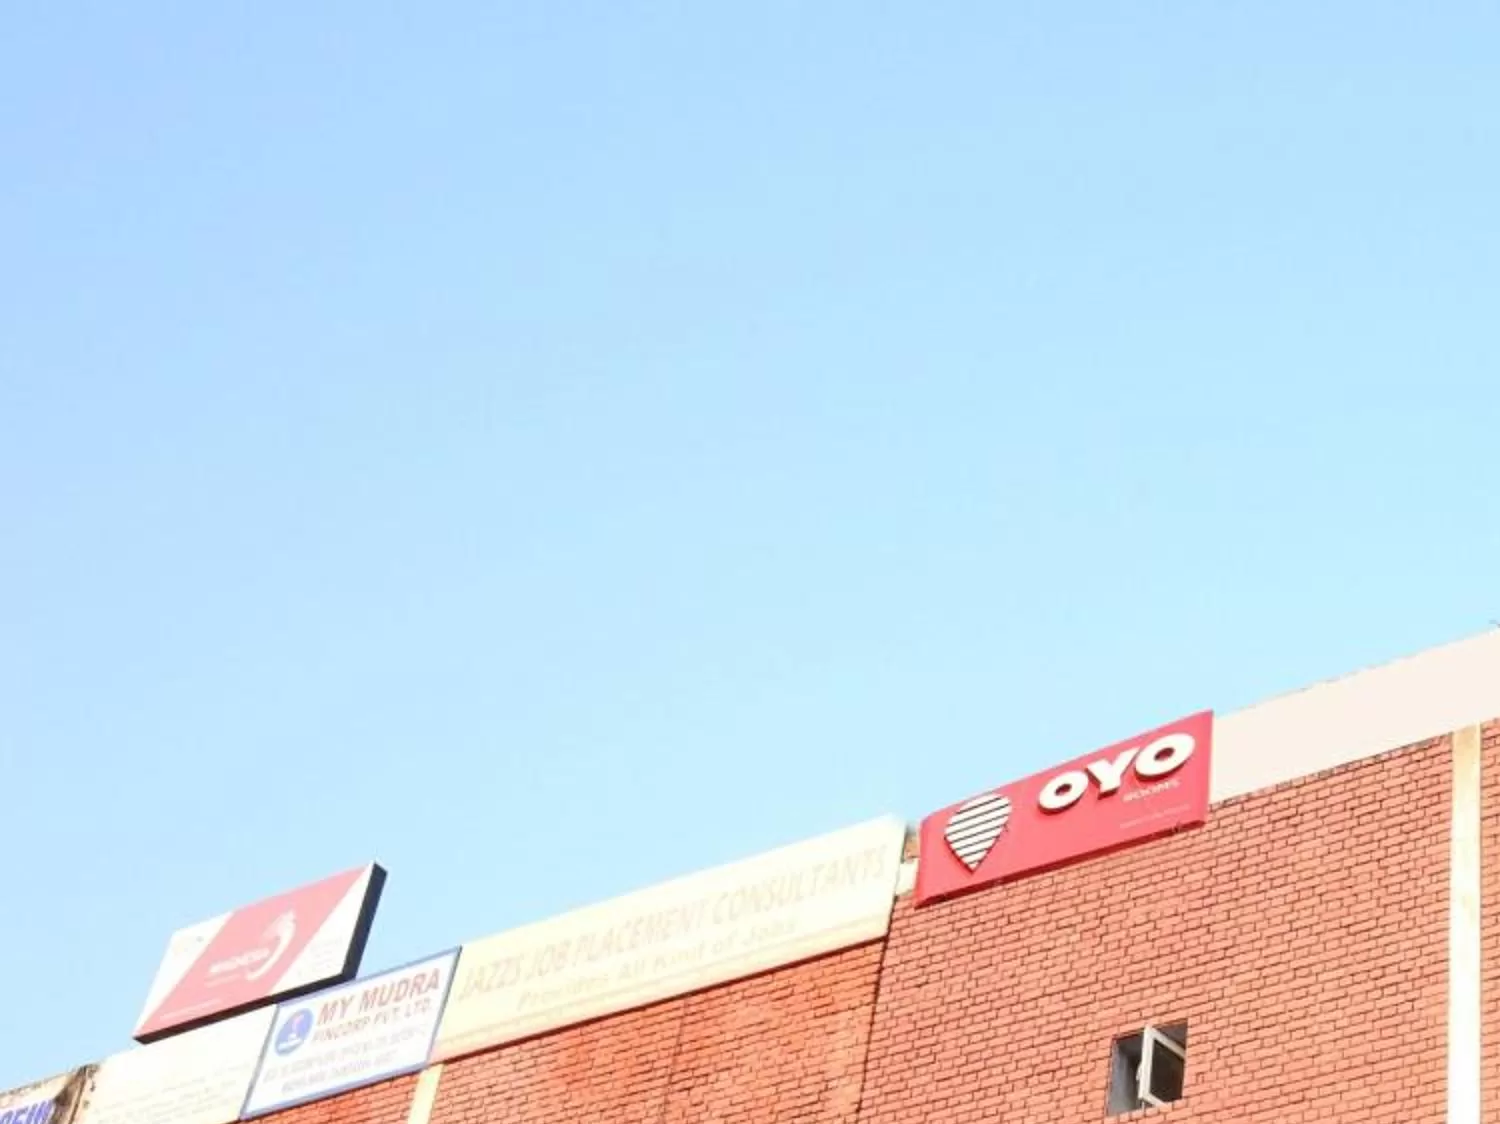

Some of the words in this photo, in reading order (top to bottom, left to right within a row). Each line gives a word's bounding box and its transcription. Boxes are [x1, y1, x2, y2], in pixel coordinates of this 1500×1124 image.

[1036, 732, 1196, 815] OYO
[572, 897, 710, 969] PLACEMENT
[712, 843, 888, 927] CONSULTANTS
[317, 996, 354, 1025] MY
[358, 968, 441, 1014] MUDRA
